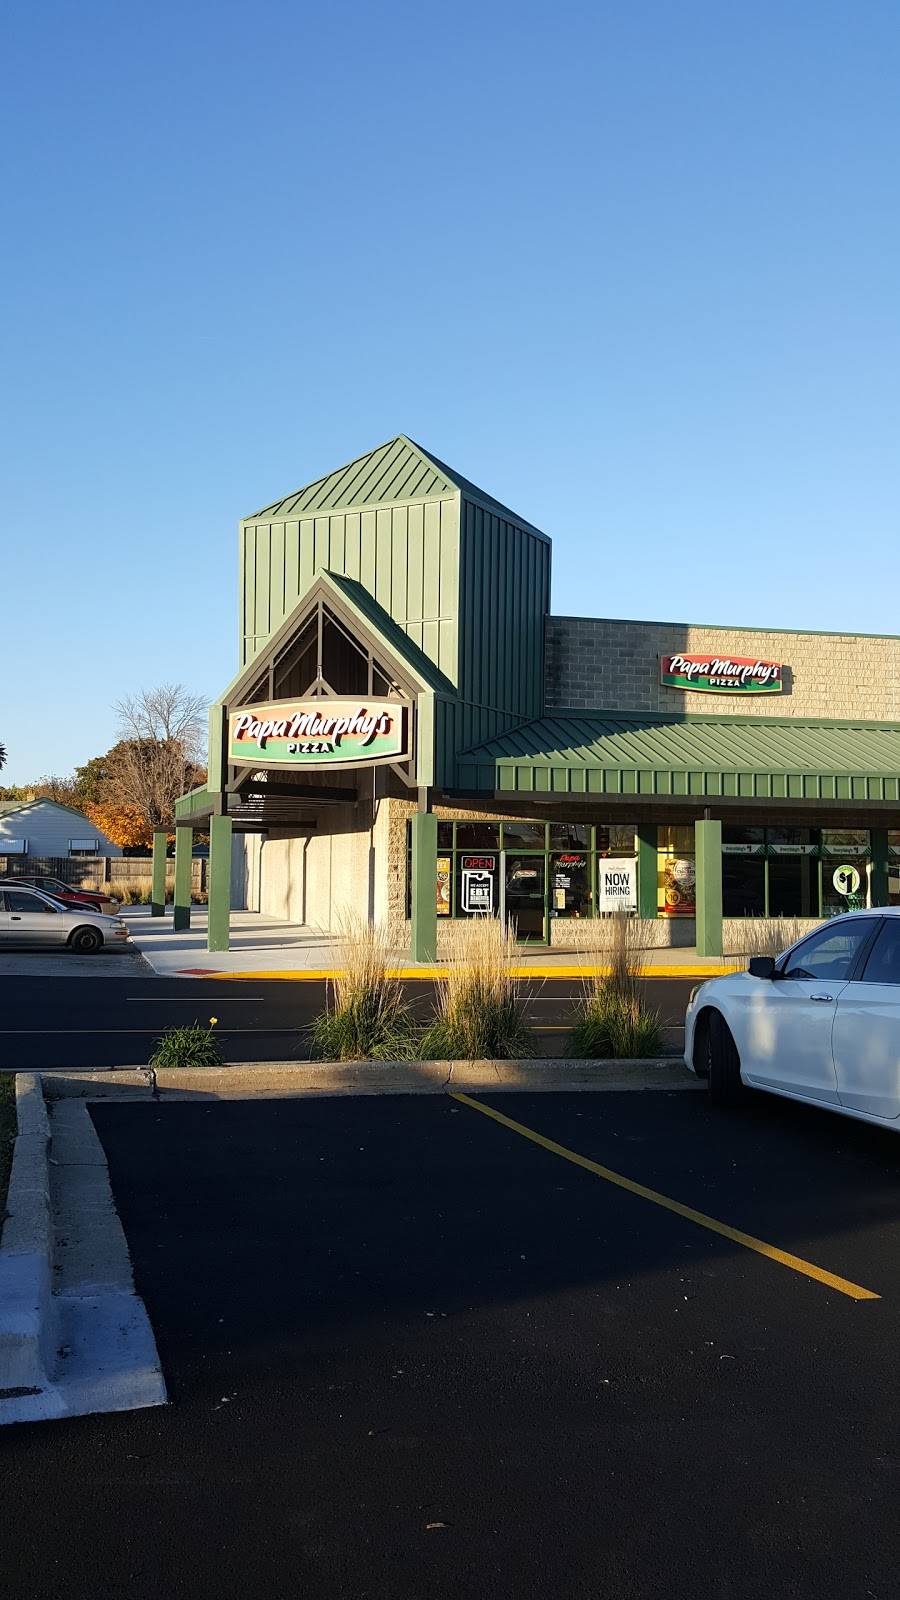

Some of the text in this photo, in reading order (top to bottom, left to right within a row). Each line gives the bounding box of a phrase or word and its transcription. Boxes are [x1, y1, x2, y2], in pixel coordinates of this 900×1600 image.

[670, 655, 780, 684] Papa Murphy's
[709, 678, 740, 687] PIZZA
[233, 707, 392, 749] Papa Murphy's
[287, 743, 332, 754] PIZZA
[464, 858, 493, 868] OPEN
[605, 873, 630, 886] NOW
[839, 871, 853, 894] $1
[470, 888, 489, 896] EBT
[605, 886, 630, 896] HIRING
